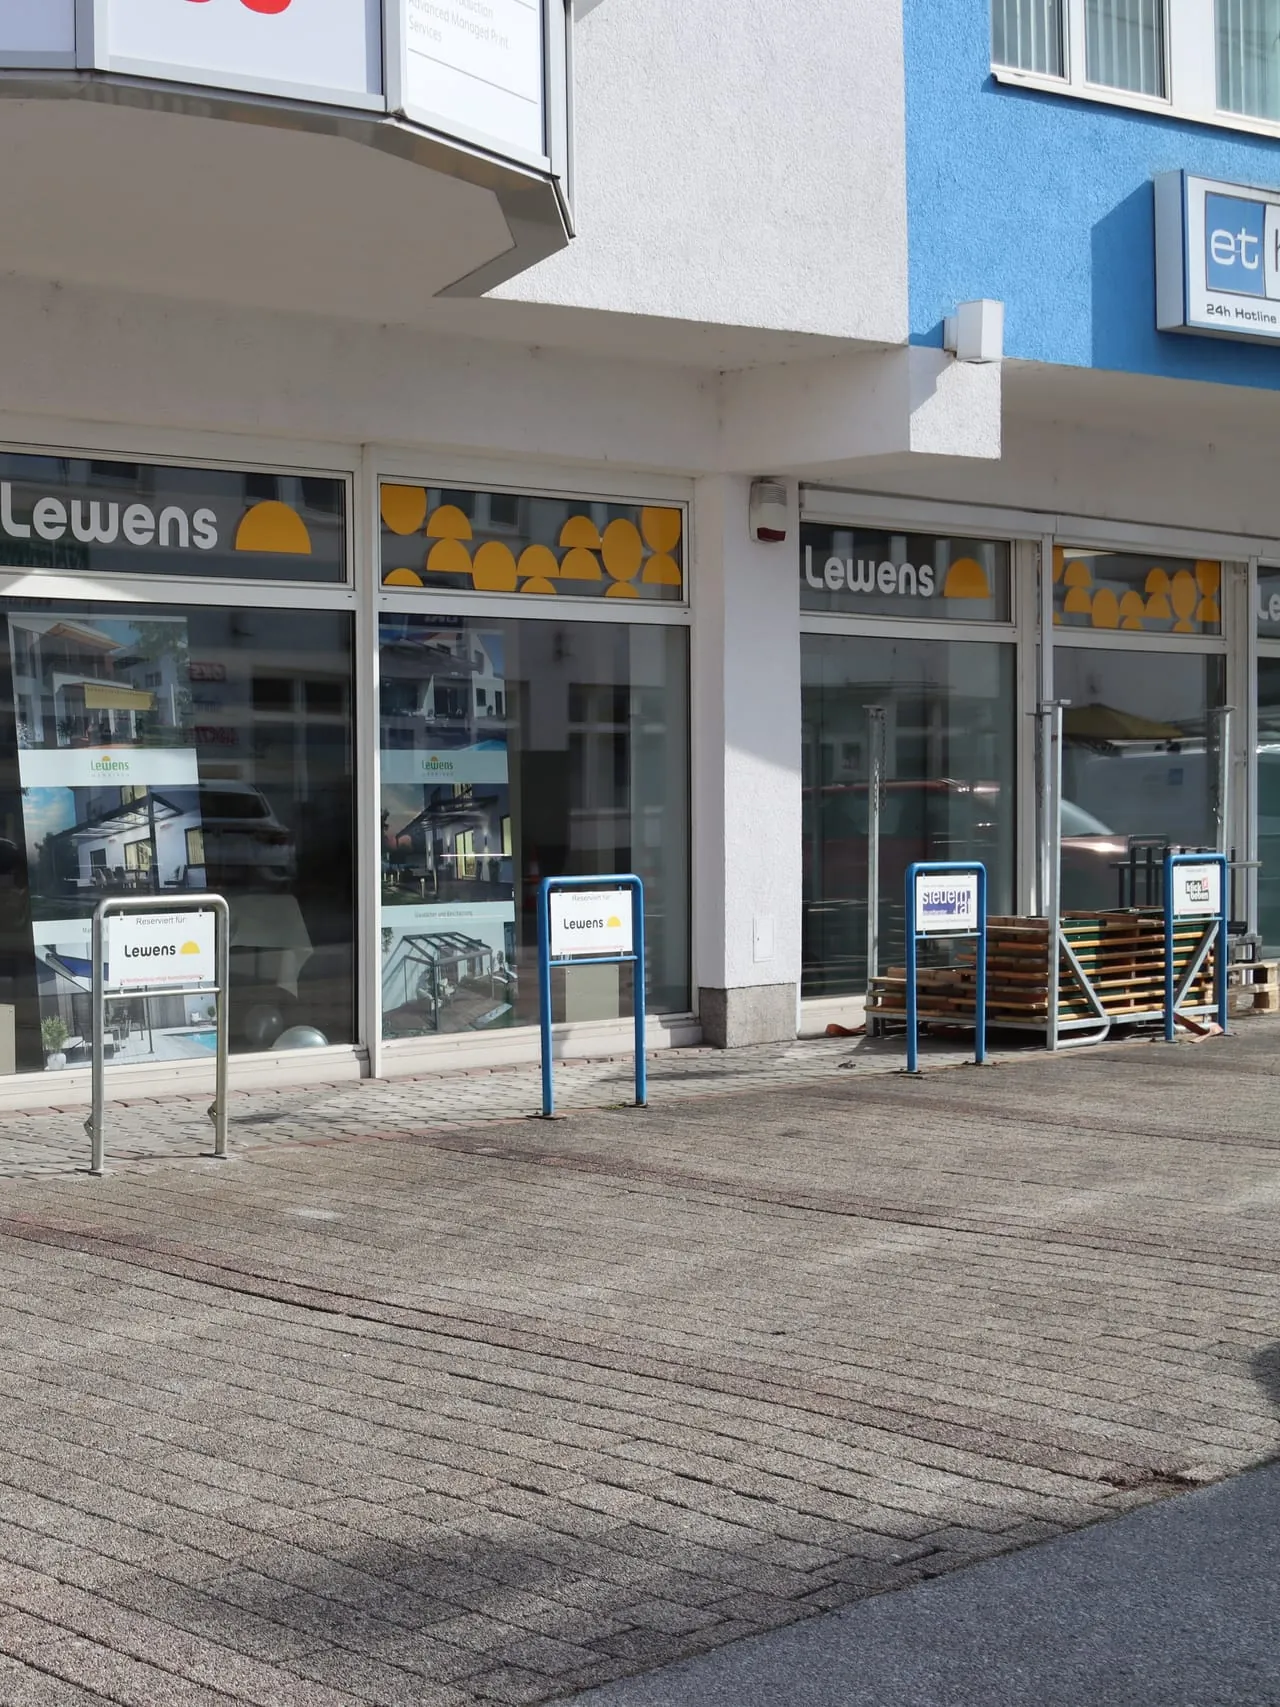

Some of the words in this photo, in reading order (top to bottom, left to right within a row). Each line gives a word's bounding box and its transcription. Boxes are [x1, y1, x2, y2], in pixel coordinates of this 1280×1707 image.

[408, 14, 442, 42] Services
[451, 11, 489, 39] Managed
[1206, 303, 1231, 317] 24h
[1235, 307, 1277, 324] Hotline
[0, 481, 218, 550] Lewens
[805, 545, 935, 597] Lewens
[90, 759, 129, 771] Lewens
[563, 918, 604, 930] Lewens
[124, 944, 176, 958] Lewens
